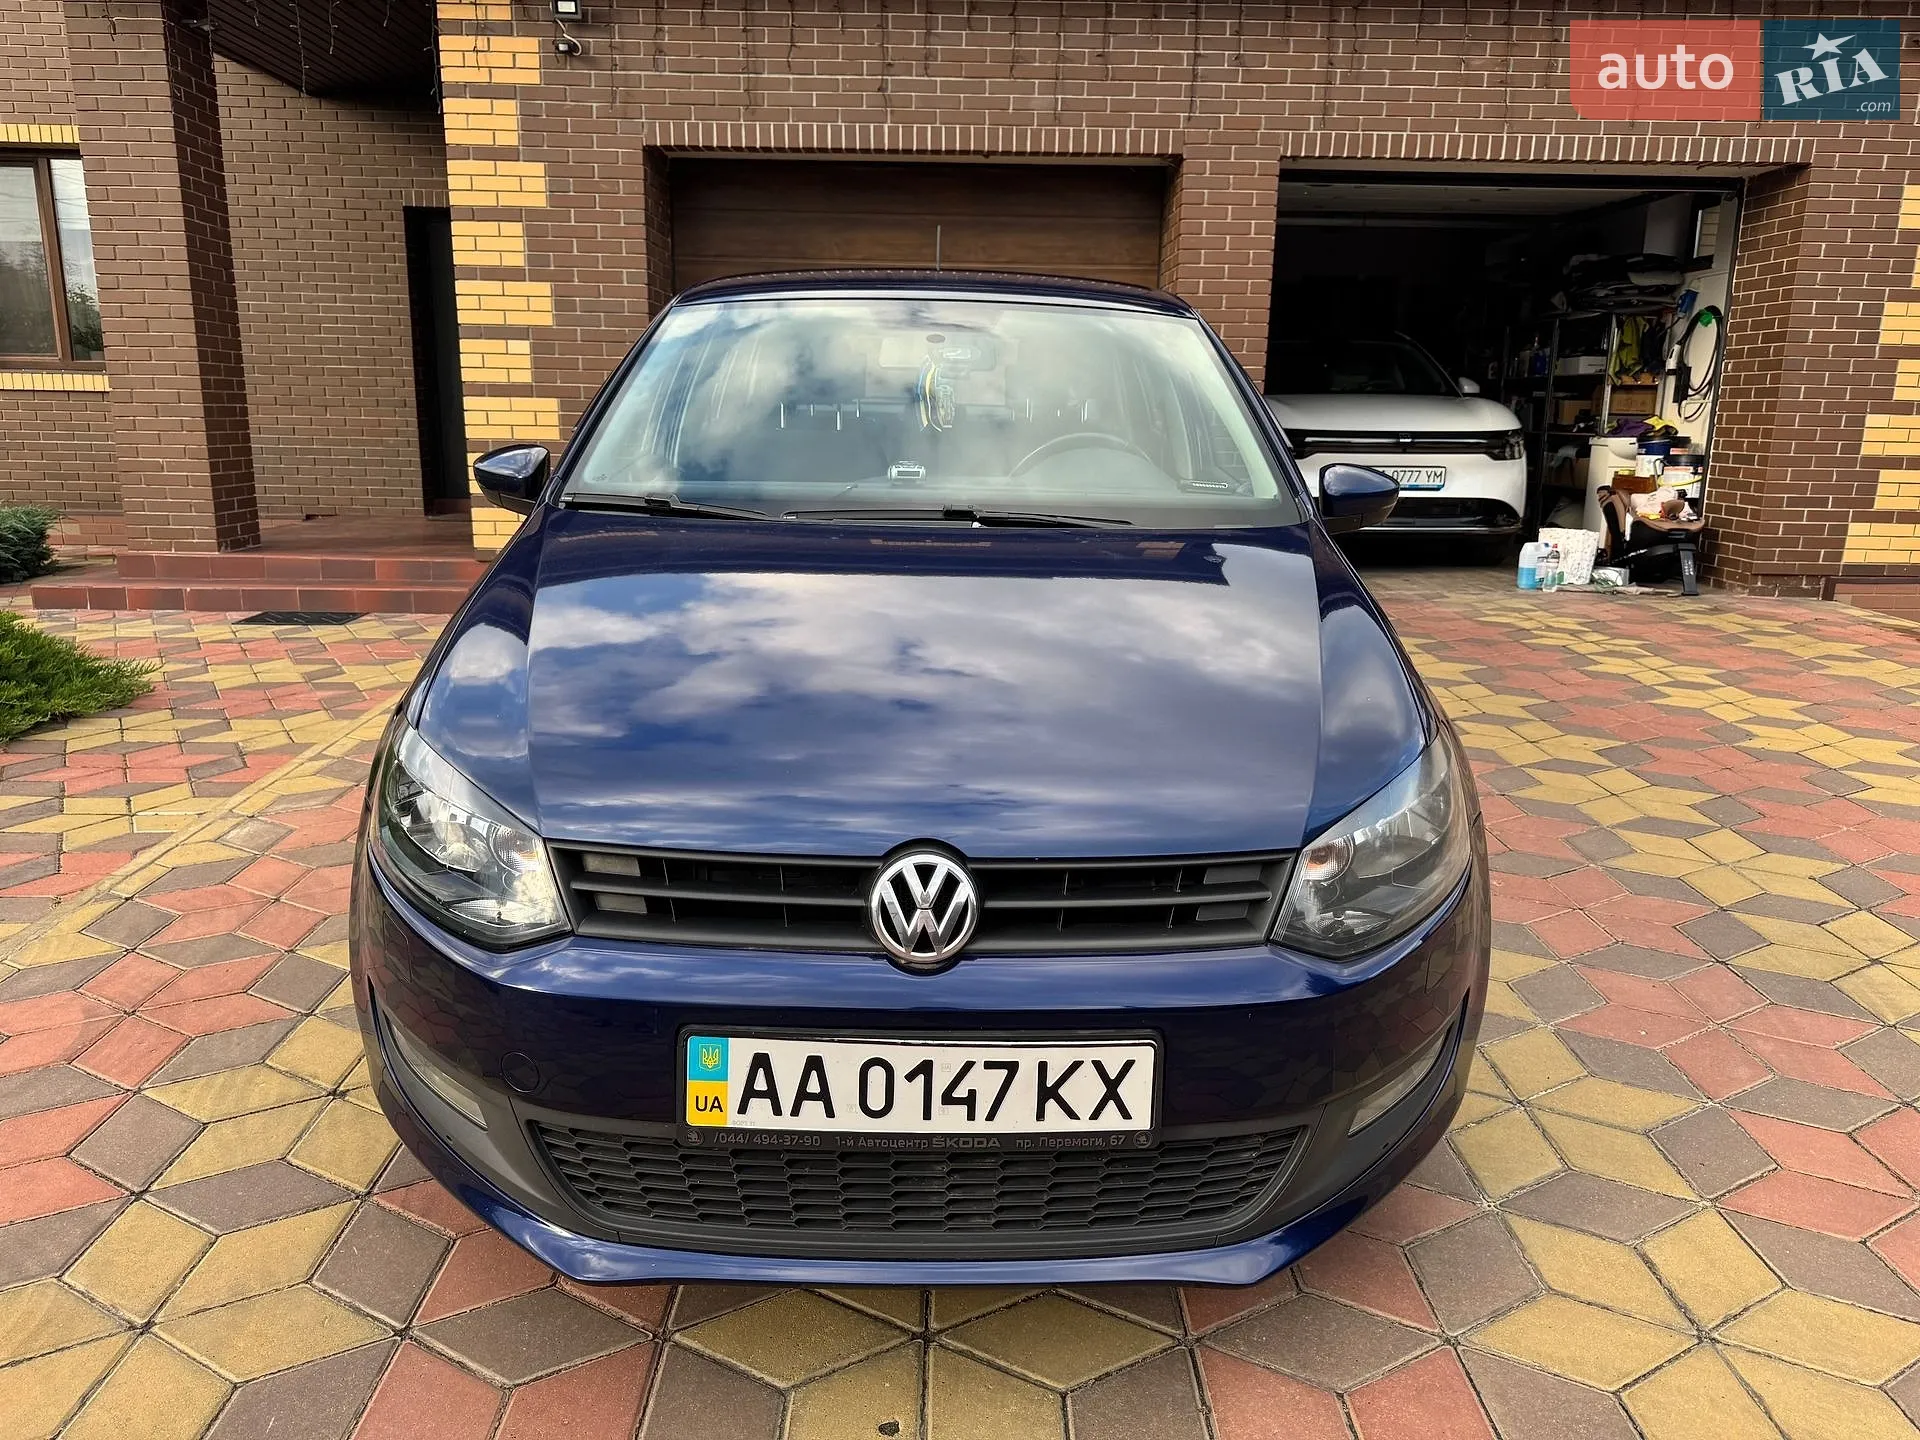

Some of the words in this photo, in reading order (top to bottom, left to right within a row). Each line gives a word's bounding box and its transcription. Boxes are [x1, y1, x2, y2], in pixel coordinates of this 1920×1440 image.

[1392, 469, 1421, 483] 0777
[1426, 470, 1443, 483] YM
[874, 857, 974, 961] VW
[737, 1051, 835, 1119] AA
[858, 1056, 1021, 1121] 0147
[1035, 1059, 1137, 1121] KX
[695, 1095, 724, 1113] UA
[713, 1131, 749, 1144] /044/
[753, 1134, 821, 1147] 494-37-90
[834, 1135, 854, 1147] 1-й
[858, 1136, 929, 1150] Автоцентр
[1016, 1138, 1035, 1149] пр.
[1039, 1135, 1106, 1149] Перемоги,
[1110, 1134, 1127, 1146] 67
